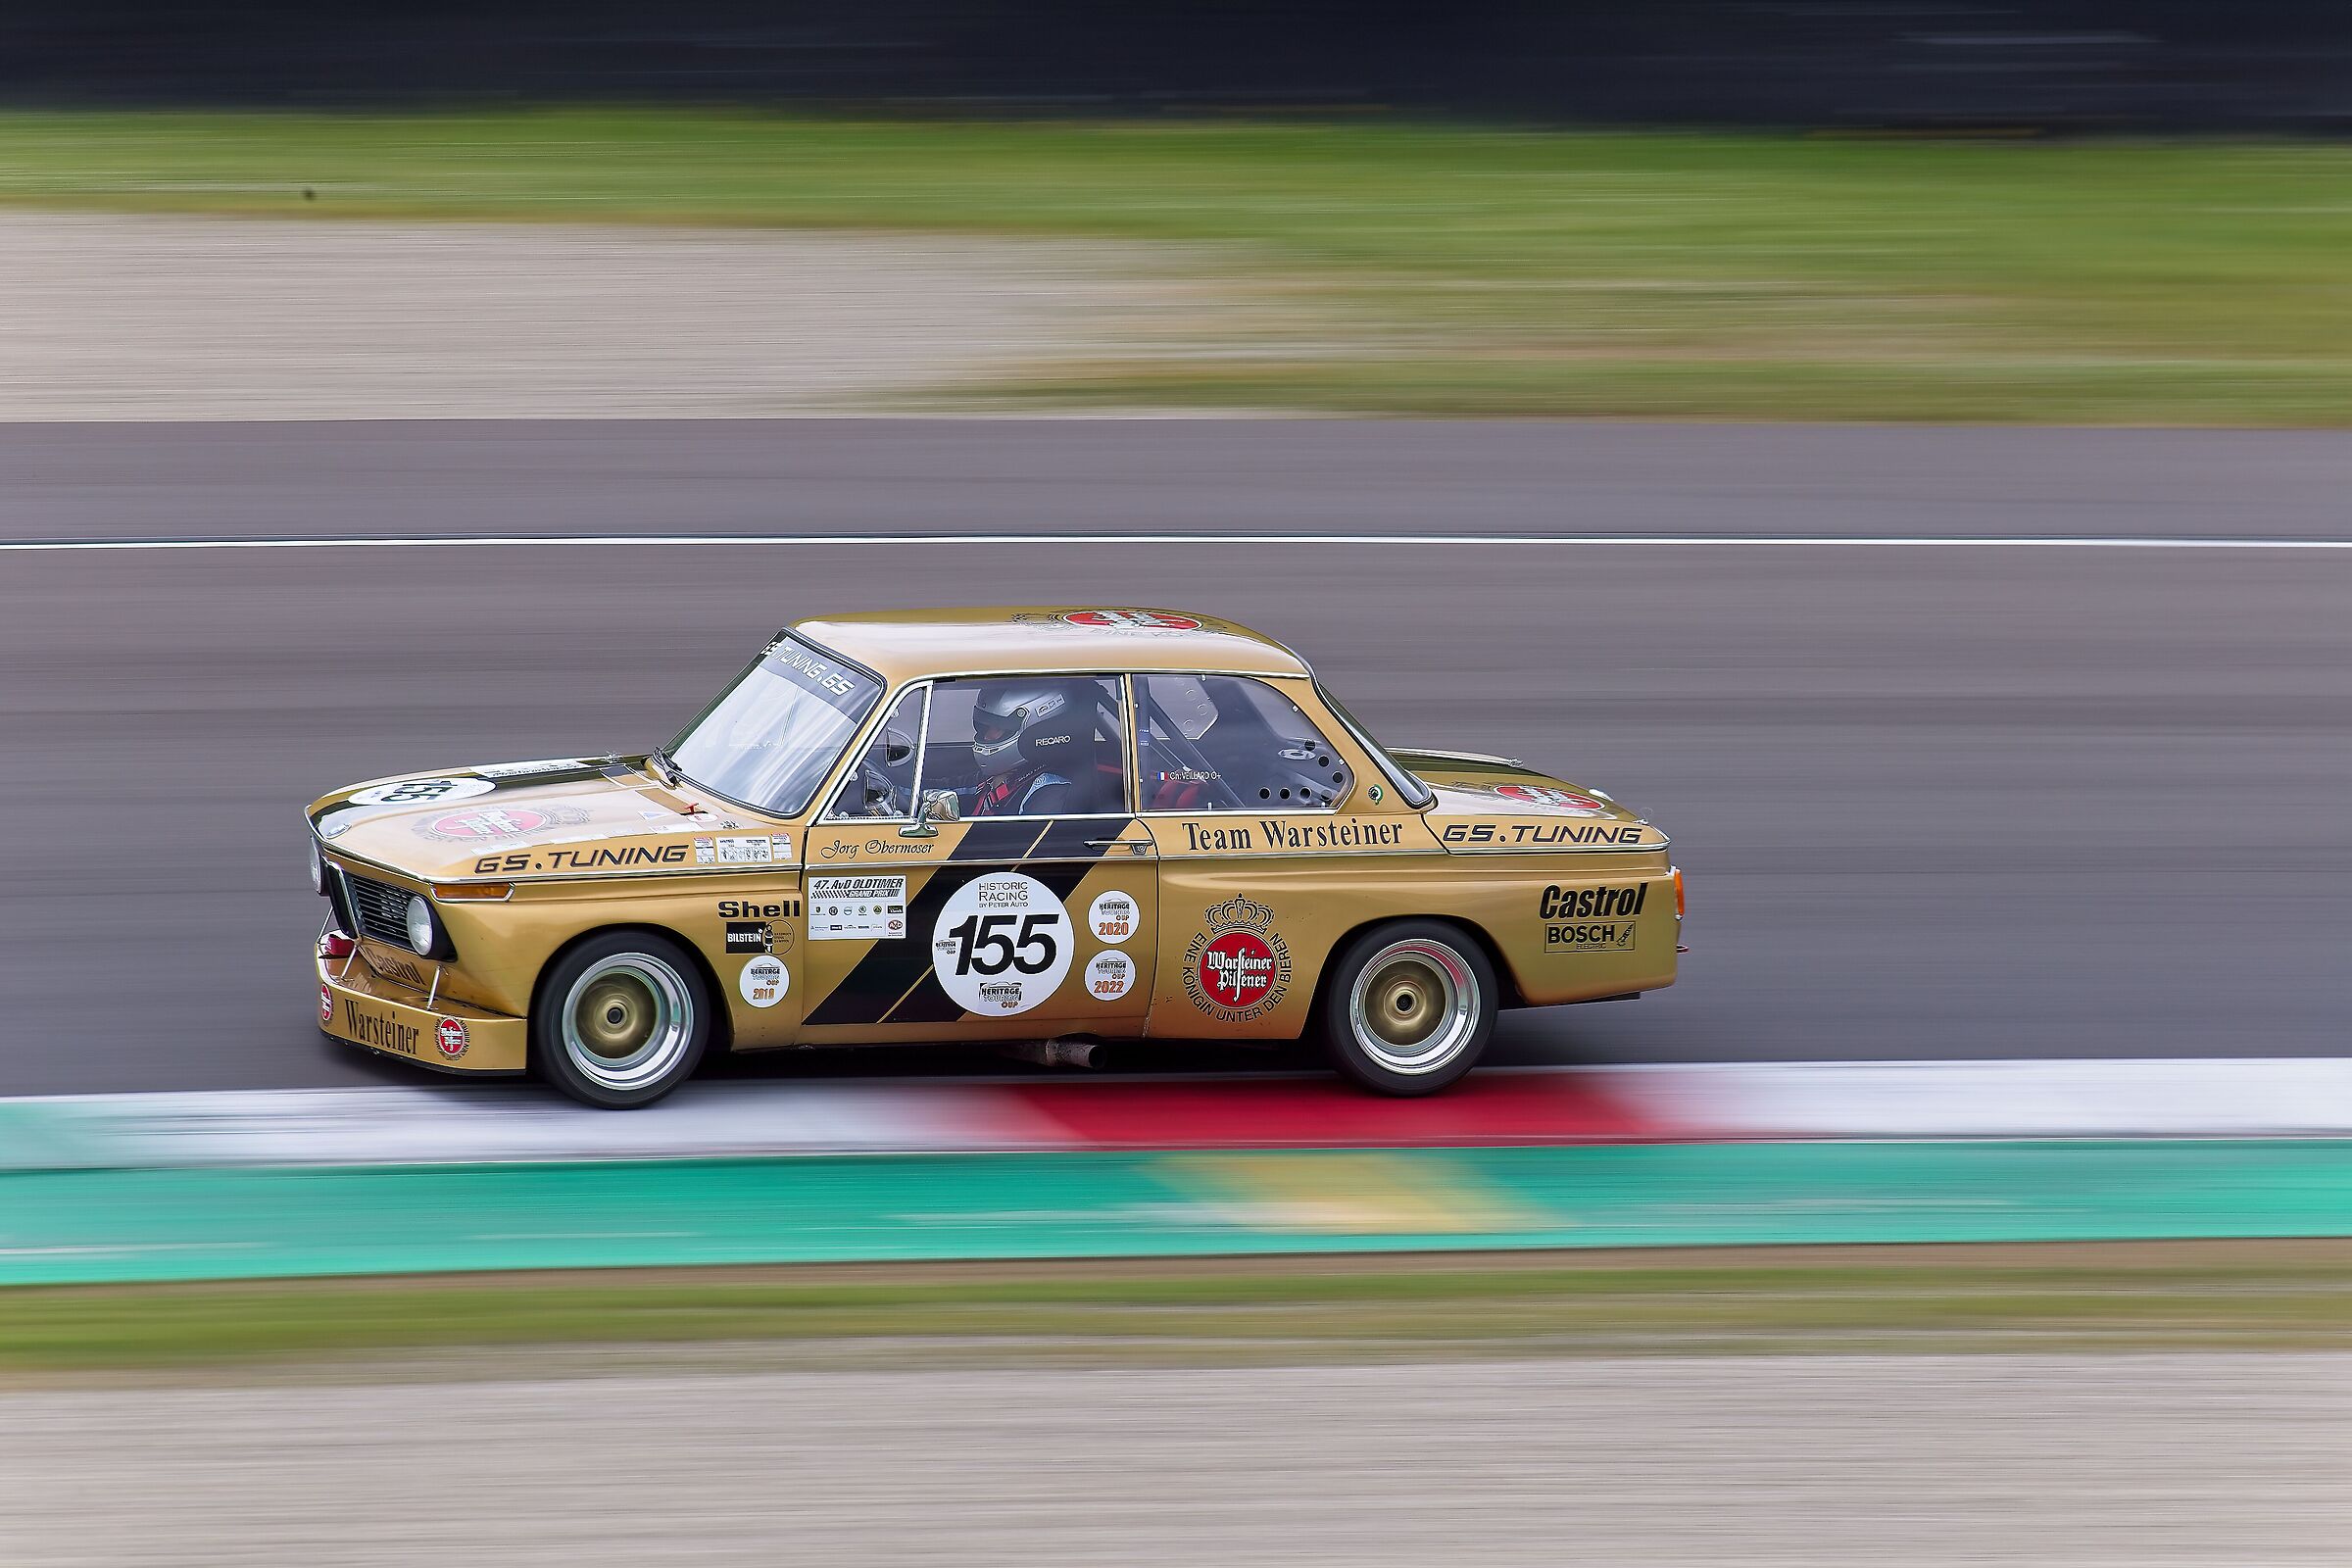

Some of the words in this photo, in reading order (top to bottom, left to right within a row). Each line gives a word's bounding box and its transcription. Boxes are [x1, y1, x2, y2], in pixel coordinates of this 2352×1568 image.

[1035, 735, 1071, 747] RECARO
[1182, 821, 1252, 851] Team
[1258, 817, 1403, 849] Warsteiner
[813, 879, 830, 890] 47.
[831, 878, 852, 890] AvD
[852, 877, 904, 889] OLDTIMER
[978, 881, 1029, 891] HISTORIC
[849, 889, 873, 899] GRAND
[874, 889, 891, 898] PRIX
[978, 890, 1029, 902] RACING
[1539, 882, 1648, 919] Castrol
[717, 900, 801, 918] Shell
[1098, 921, 1129, 936] 2020
[1547, 924, 1616, 944] BOSCH
[726, 933, 761, 943] BILSTEIN
[949, 913, 1060, 976] 155
[1182, 932, 1208, 963] EINE
[1268, 932, 1293, 984] BIEREN
[981, 987, 1020, 996] HERITAGE
[1094, 980, 1124, 994] 2022
[1182, 965, 1216, 1016] KÖNIGIN
[1262, 984, 1288, 1012] DEN
[1216, 1007, 1264, 1022] UNTER
[344, 998, 419, 1055] Warsteiner
